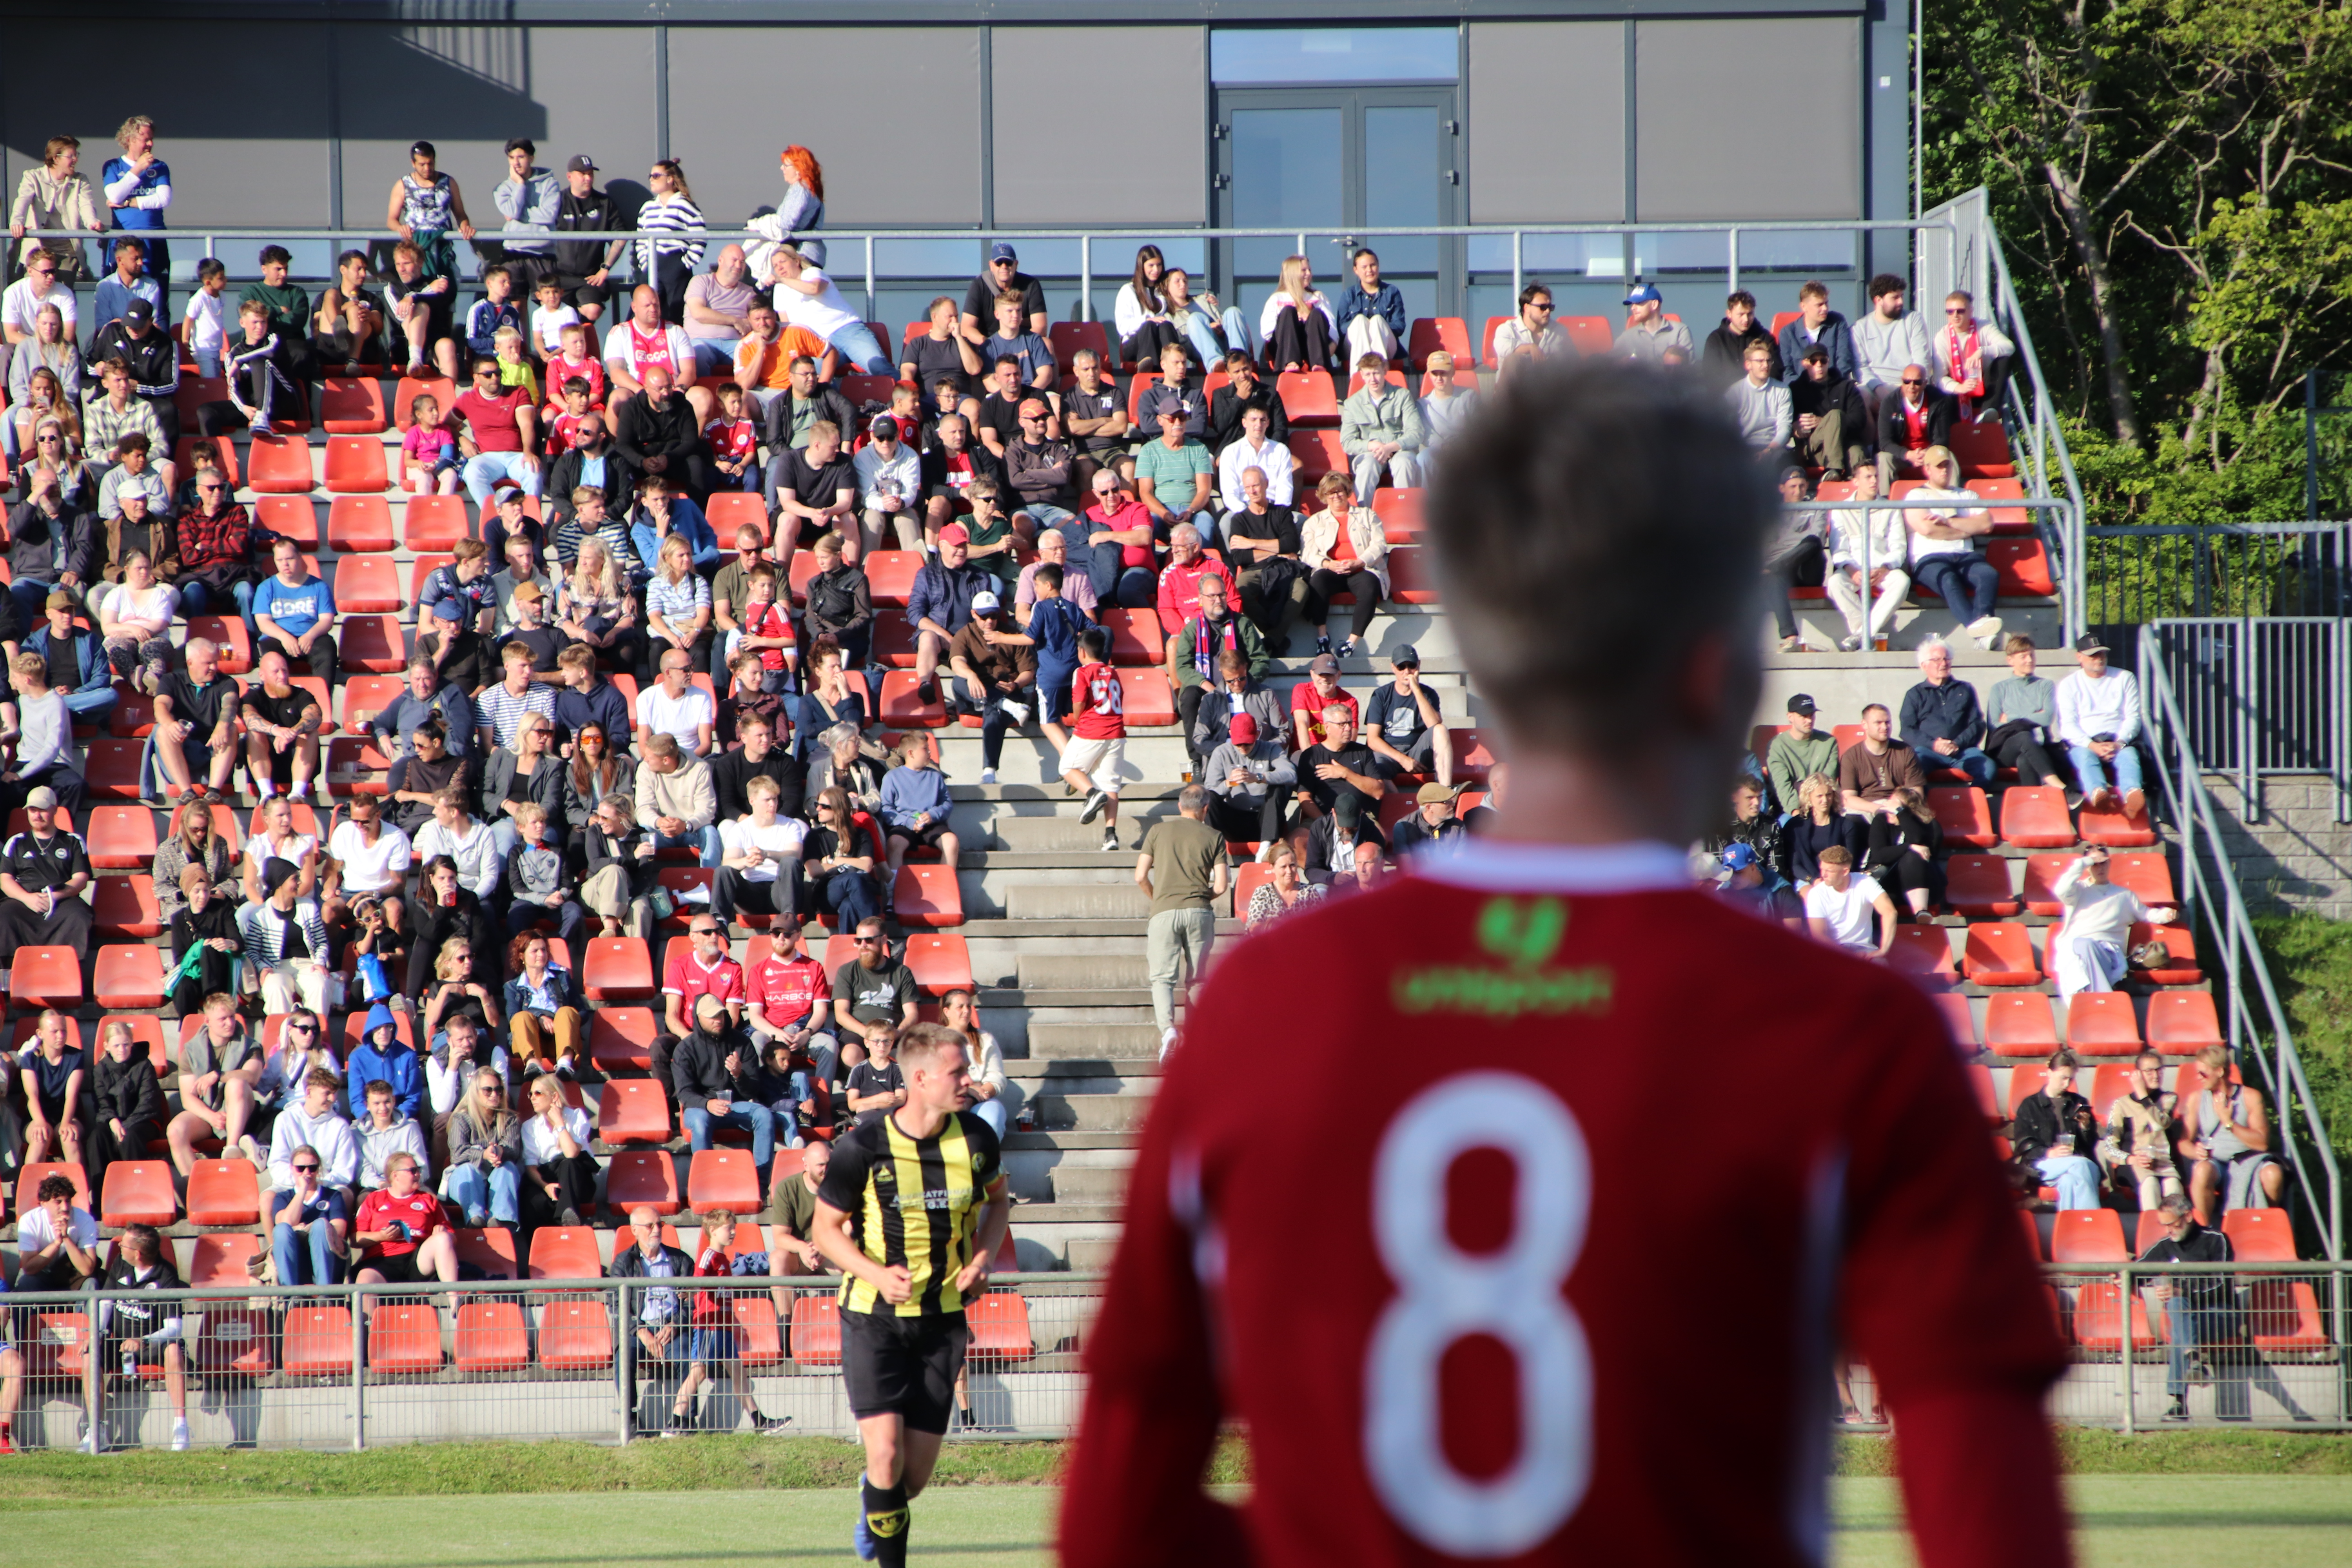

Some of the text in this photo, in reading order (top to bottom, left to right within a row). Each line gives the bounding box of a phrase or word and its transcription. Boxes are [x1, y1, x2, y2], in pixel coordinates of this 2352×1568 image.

[635, 349, 668, 363] Ziggo
[1101, 396, 1114, 409] 75
[946, 471, 971, 484] AMEDAY
[270, 598, 317, 619] CORE
[1091, 679, 1122, 715] 58
[765, 993, 813, 1002] HARBOE
[1363, 1068, 1596, 1559] 8
